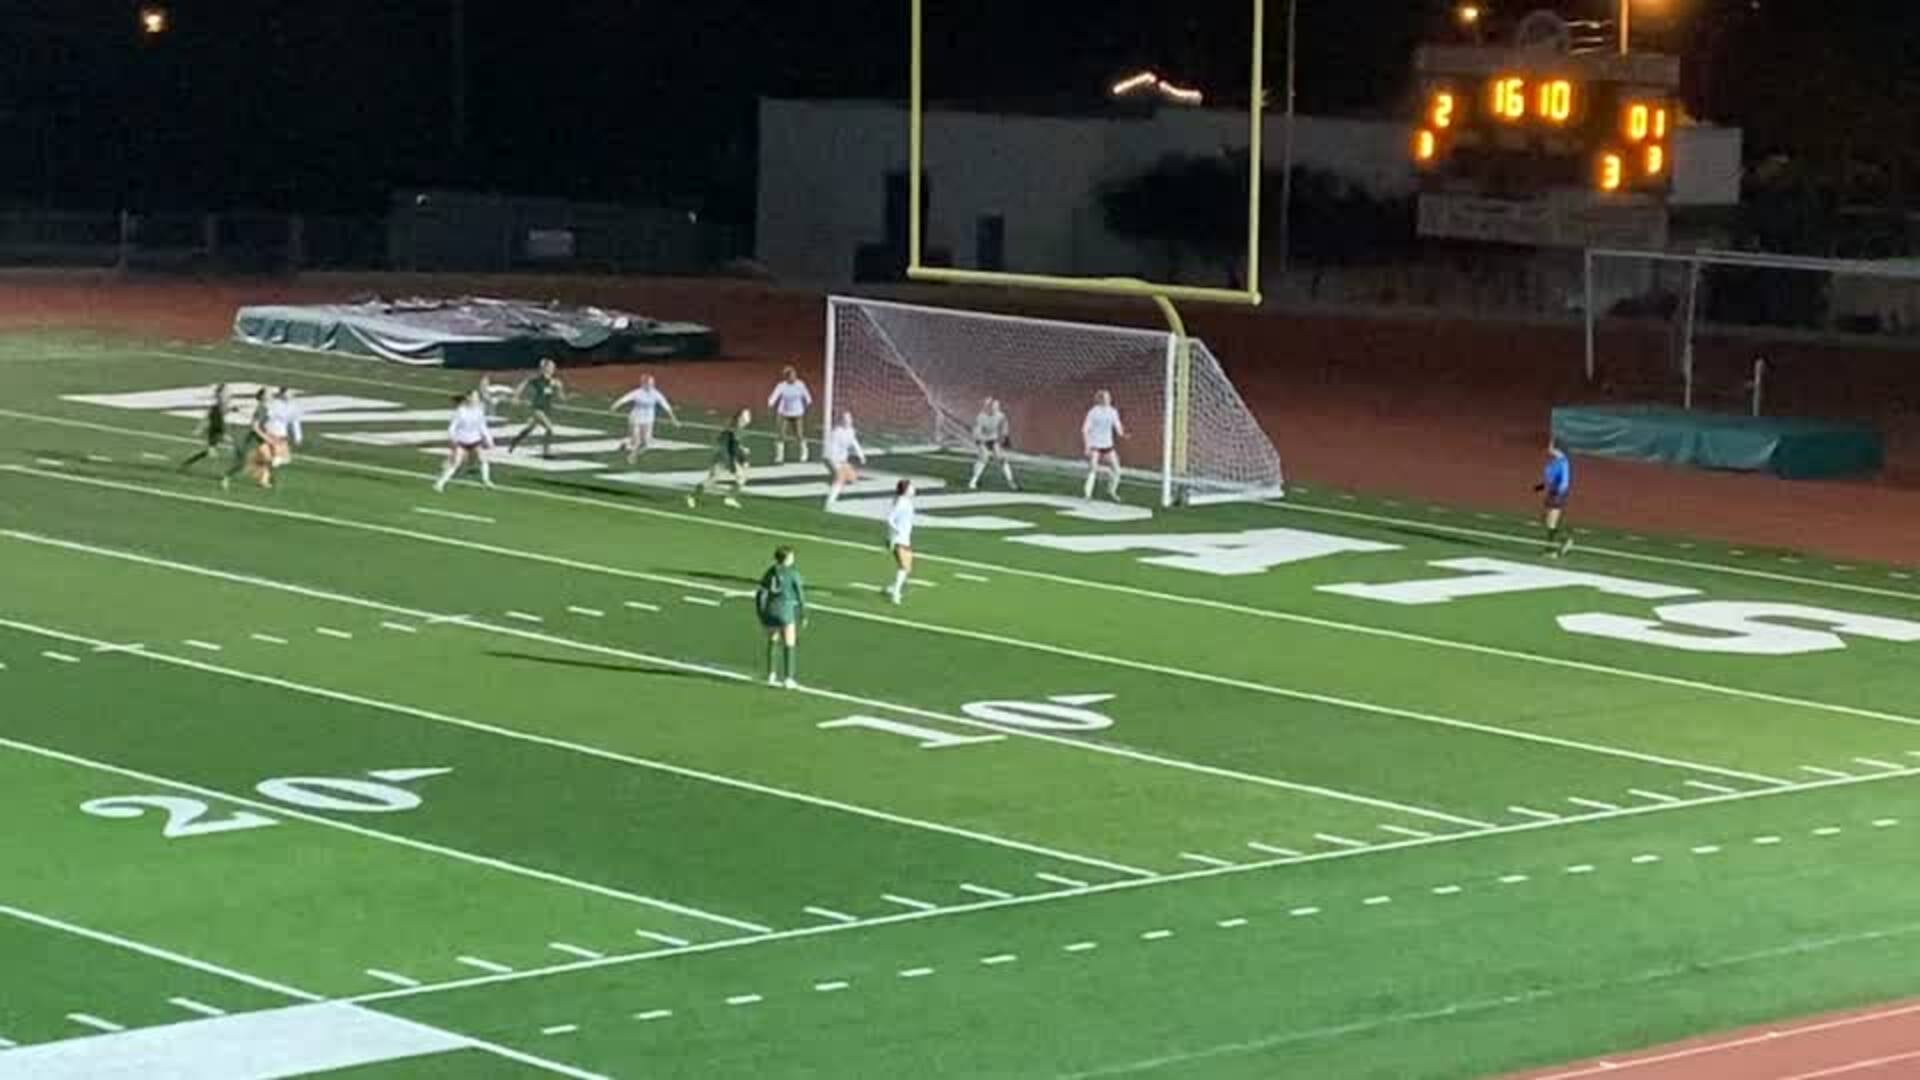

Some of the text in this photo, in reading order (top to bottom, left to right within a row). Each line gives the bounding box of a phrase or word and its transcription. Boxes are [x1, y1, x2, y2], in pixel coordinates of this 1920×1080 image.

[1494, 77, 1571, 121] 16 10
[1599, 153, 1622, 190] 3
[815, 699, 1115, 751] 10
[79, 775, 424, 838] 20
